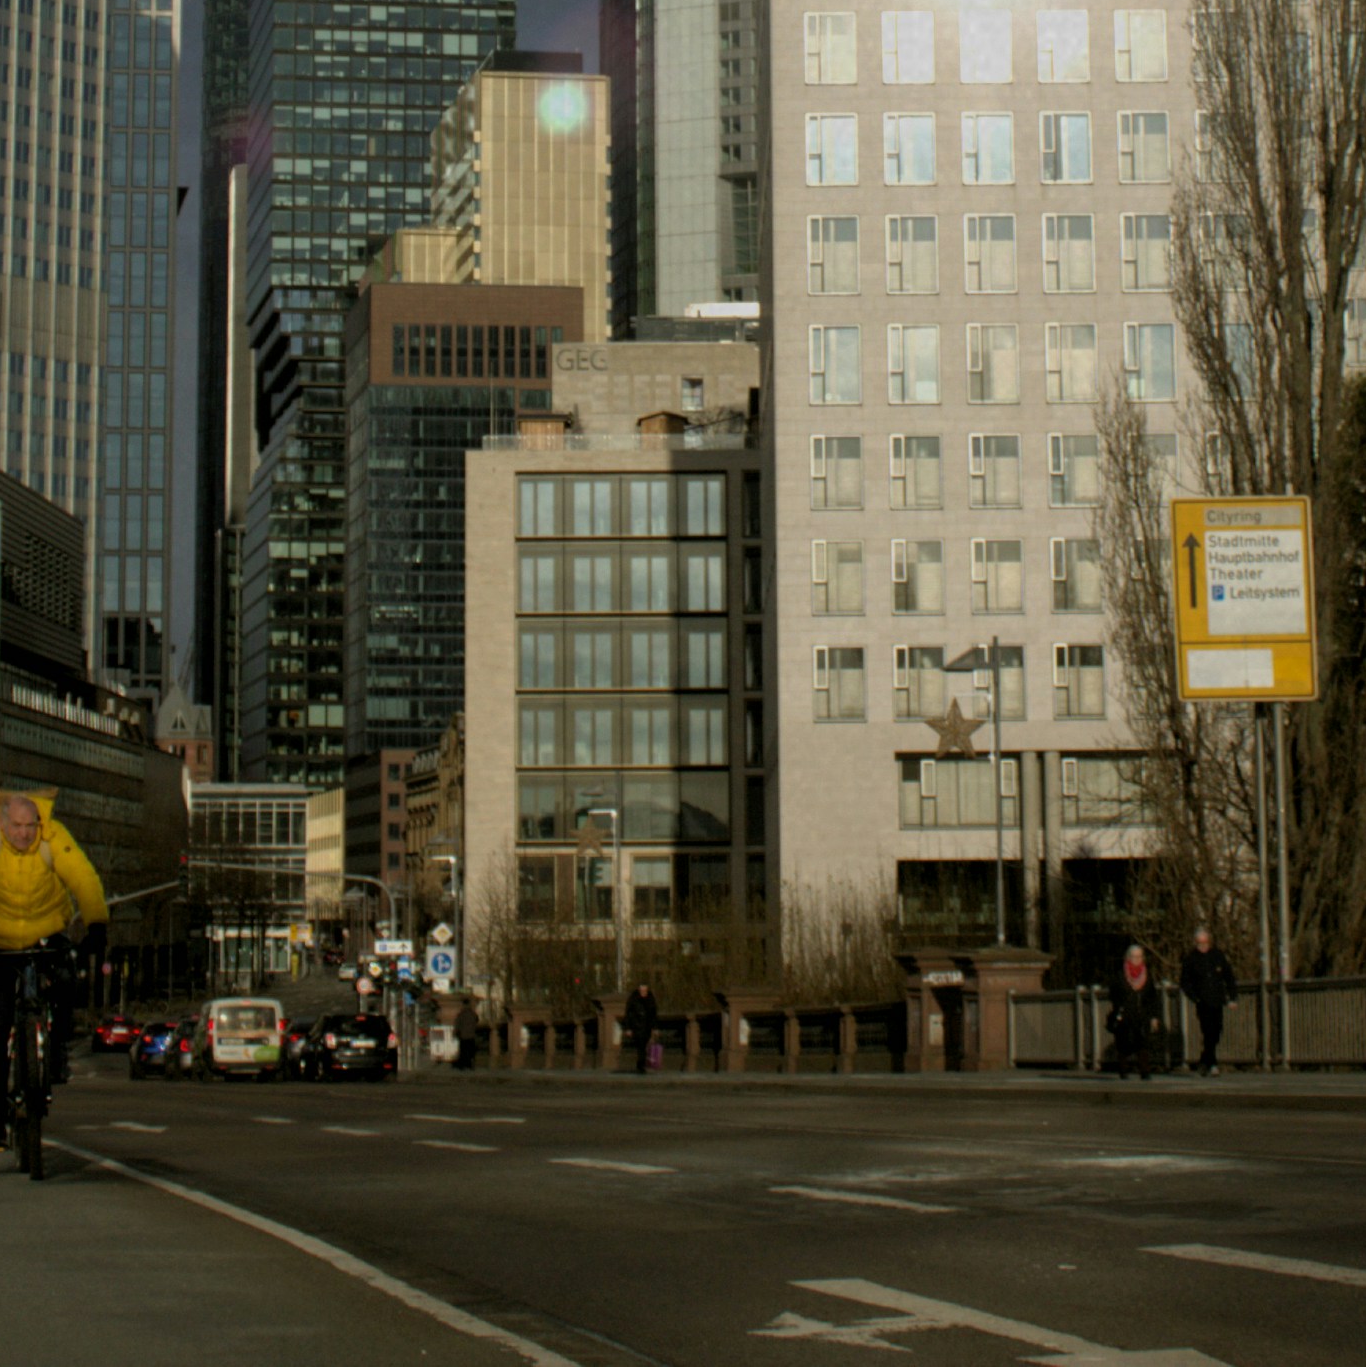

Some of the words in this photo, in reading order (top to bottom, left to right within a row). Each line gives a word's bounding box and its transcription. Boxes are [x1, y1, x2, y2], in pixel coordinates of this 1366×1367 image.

[556, 348, 609, 372] GEG
[1207, 510, 1262, 525] Cityring
[1208, 535, 1279, 547] Stadtmitte
[1208, 550, 1300, 566] Hauptbahnhof
[1210, 567, 1263, 580] Theater
[1229, 586, 1301, 601] Leitsystem
